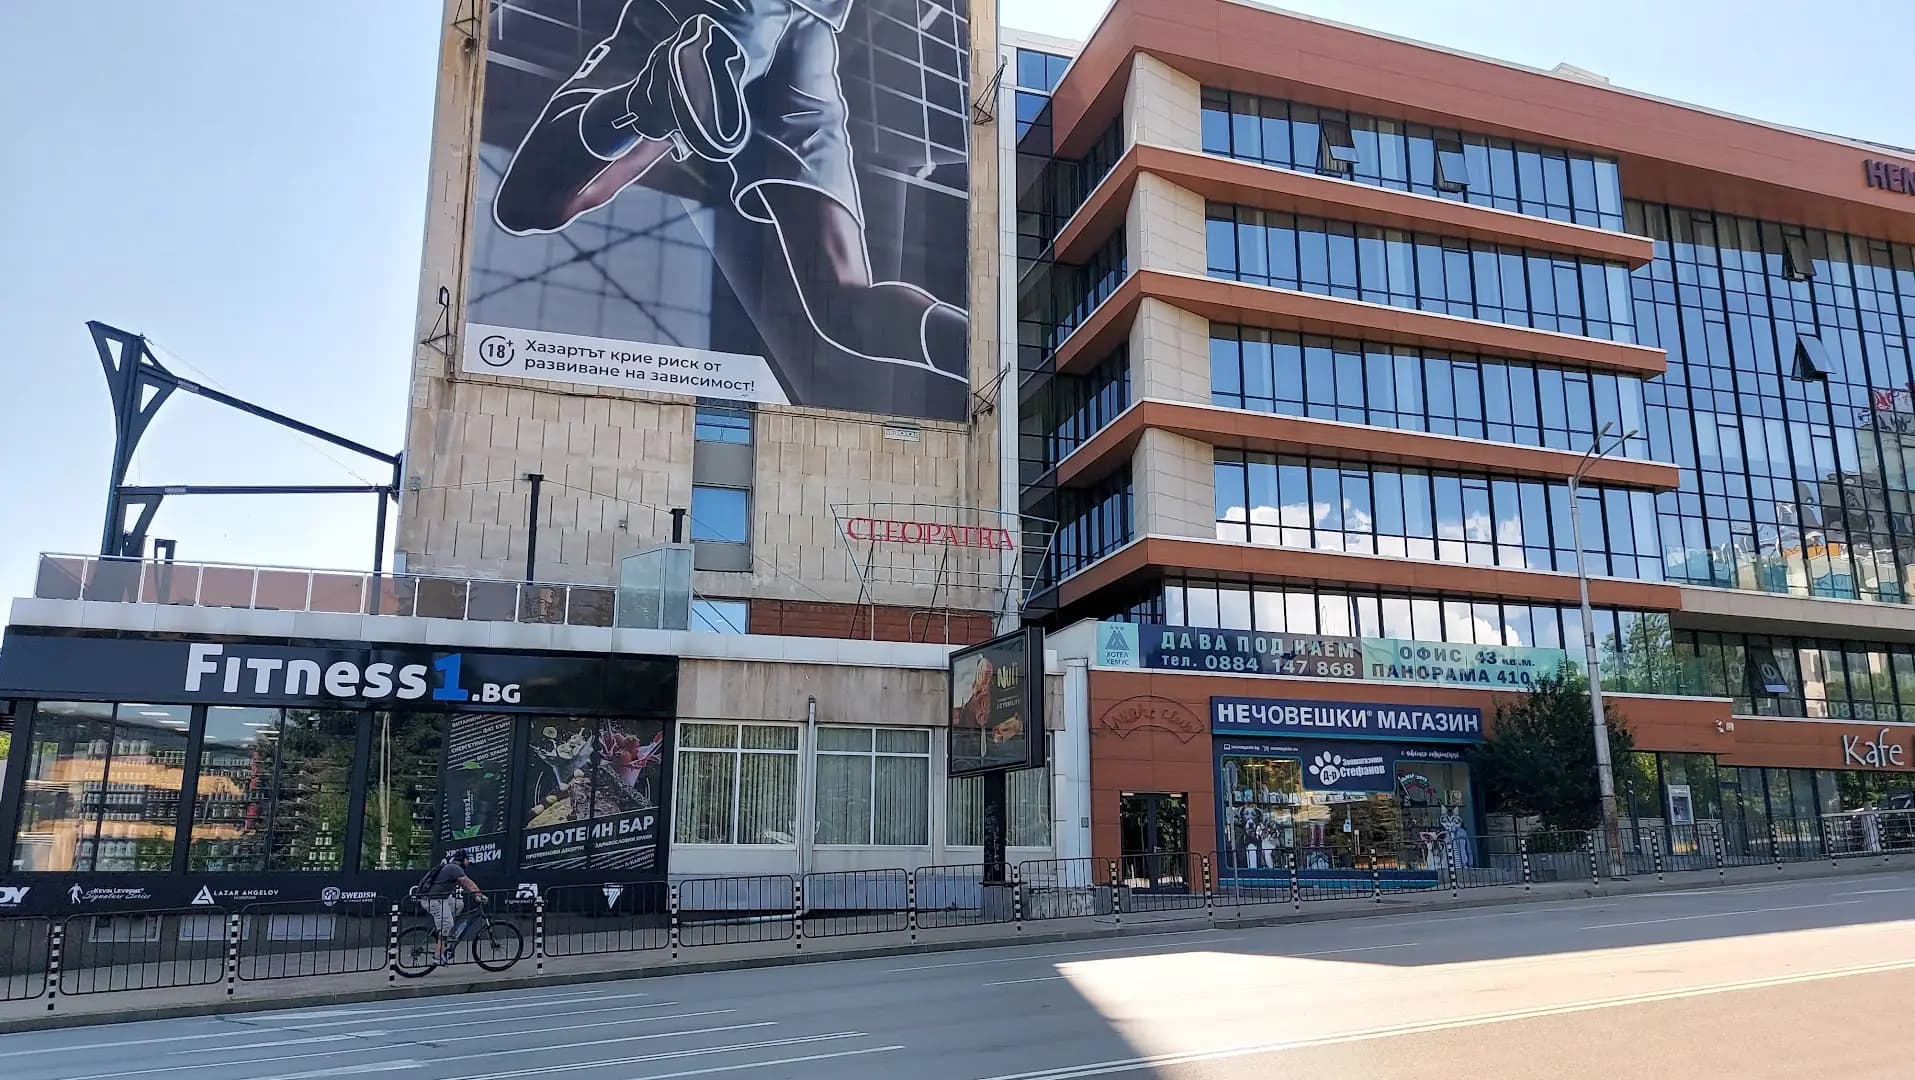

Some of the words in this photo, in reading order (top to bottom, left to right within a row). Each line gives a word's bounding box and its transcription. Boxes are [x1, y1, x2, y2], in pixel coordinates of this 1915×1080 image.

[487, 339, 515, 359] 18+
[525, 338, 606, 360] Хазартът
[610, 349, 652, 364] крие
[658, 355, 700, 369] риск
[703, 361, 722, 373] от
[524, 357, 620, 377] развиване
[625, 369, 645, 380] на
[650, 371, 755, 392] зависимост!
[846, 517, 1014, 550] CLEOPATRA
[1105, 651, 1129, 659] ХОТЕЛ
[1161, 631, 1228, 652] ДАВА
[1237, 636, 1284, 656] ПОД
[1294, 640, 1355, 659] НАЕМ
[1399, 645, 1462, 663] ОФИС
[1475, 650, 1497, 665] 43
[1161, 654, 1198, 668] тел.
[1205, 654, 1259, 672] 0884
[1272, 659, 1308, 674] 147
[1316, 660, 1355, 677] 868
[1372, 664, 1490, 683] ПАНОРАМА
[1496, 670, 1530, 686] 410
[1377, 710, 1479, 732] МАГАЗИН
[1843, 728, 1904, 768] Kafe
[1340, 765, 1385, 778] Стефанов
[526, 822, 614, 850] ПРОТЕИН
[618, 815, 654, 834] БАР
[341, 891, 377, 899] SWEDISH
